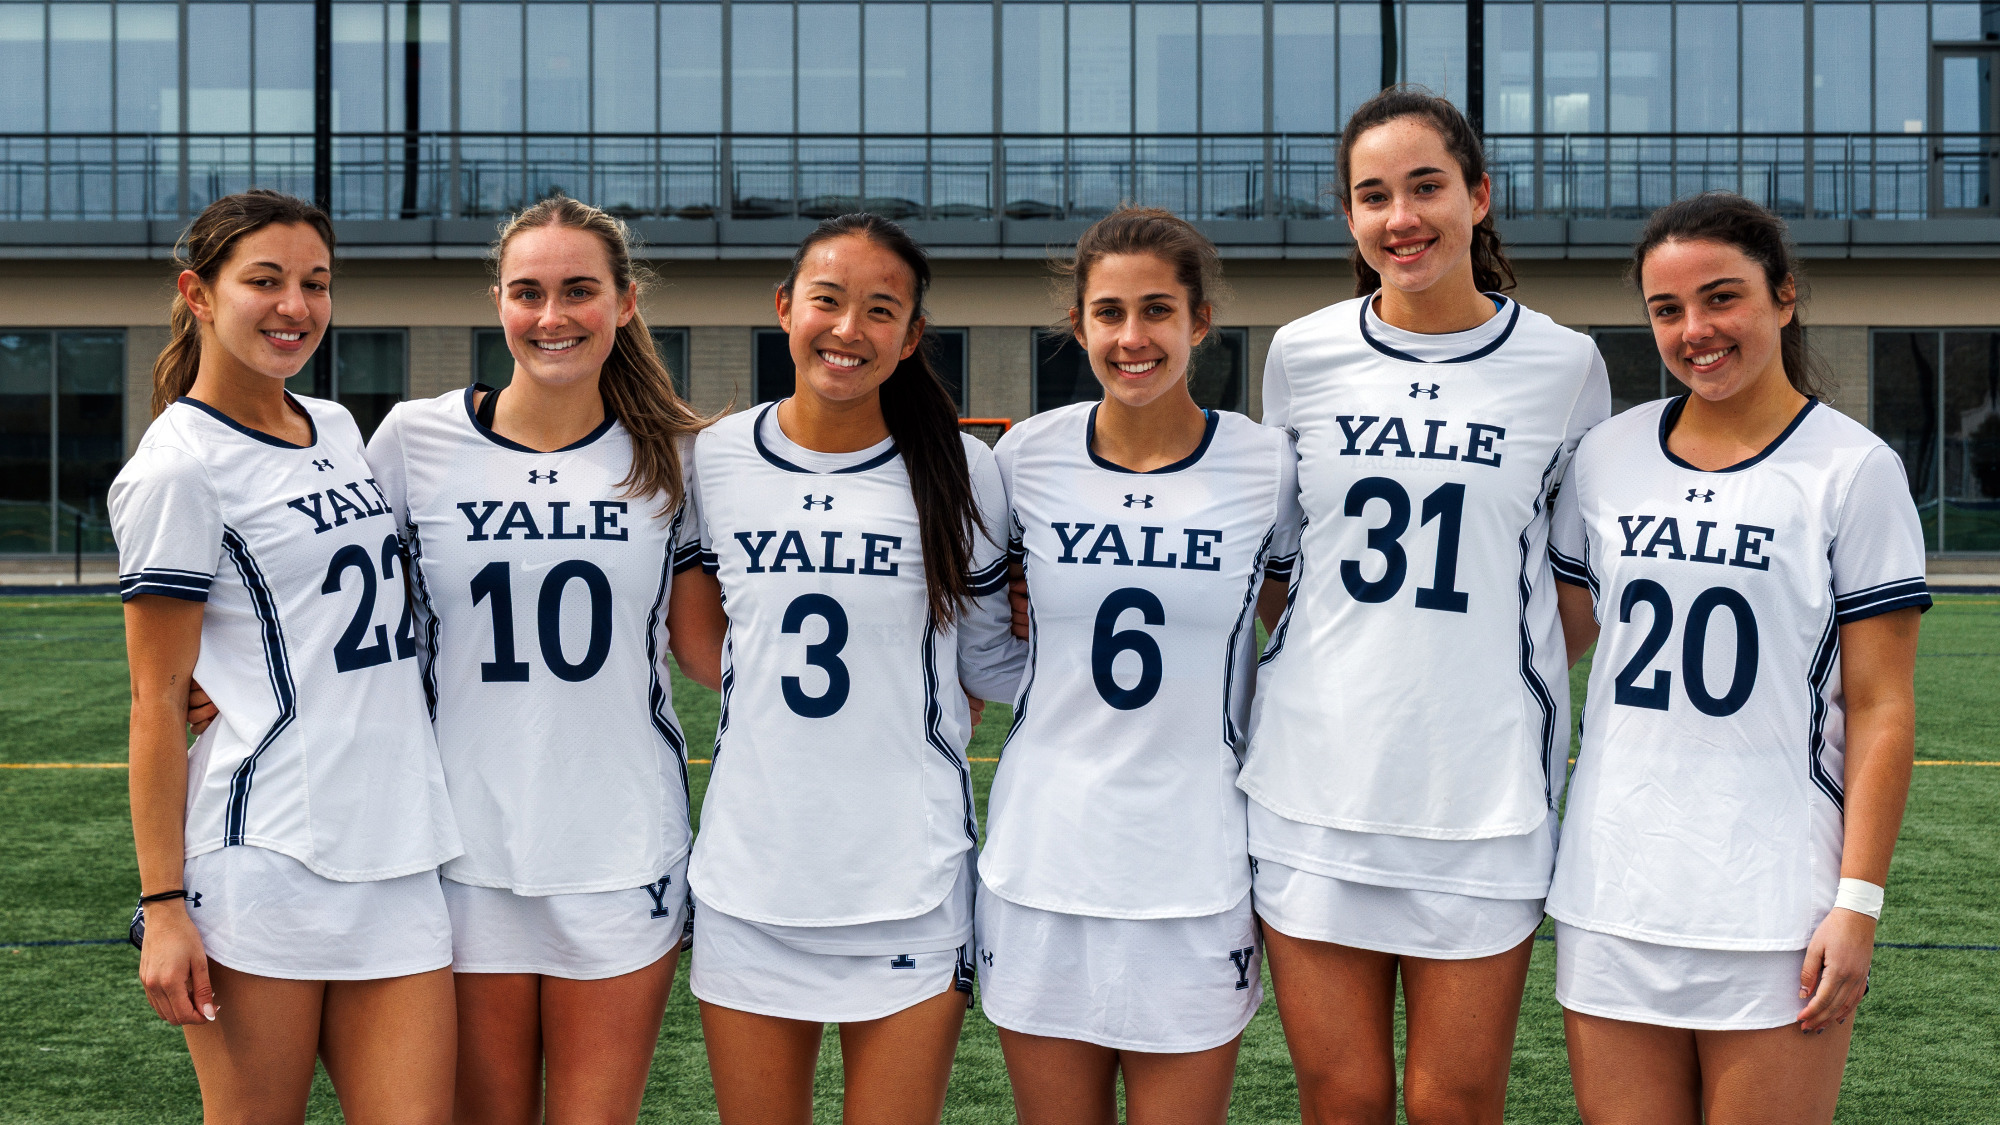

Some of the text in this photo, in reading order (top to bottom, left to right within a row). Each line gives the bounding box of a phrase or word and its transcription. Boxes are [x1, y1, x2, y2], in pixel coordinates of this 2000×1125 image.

[1336, 416, 1505, 468] YALE
[457, 501, 628, 541] YALE
[1051, 522, 1222, 571] YALE
[1340, 477, 1468, 613] 31
[1618, 516, 1774, 571] YALE
[734, 531, 902, 576] YALE
[321, 534, 416, 673] 22
[470, 560, 612, 682] 10
[781, 593, 850, 718] 3
[1092, 587, 1165, 710] 6
[1615, 579, 1759, 717] 20
[639, 875, 671, 919] Y
[1229, 946, 1254, 990] Y
